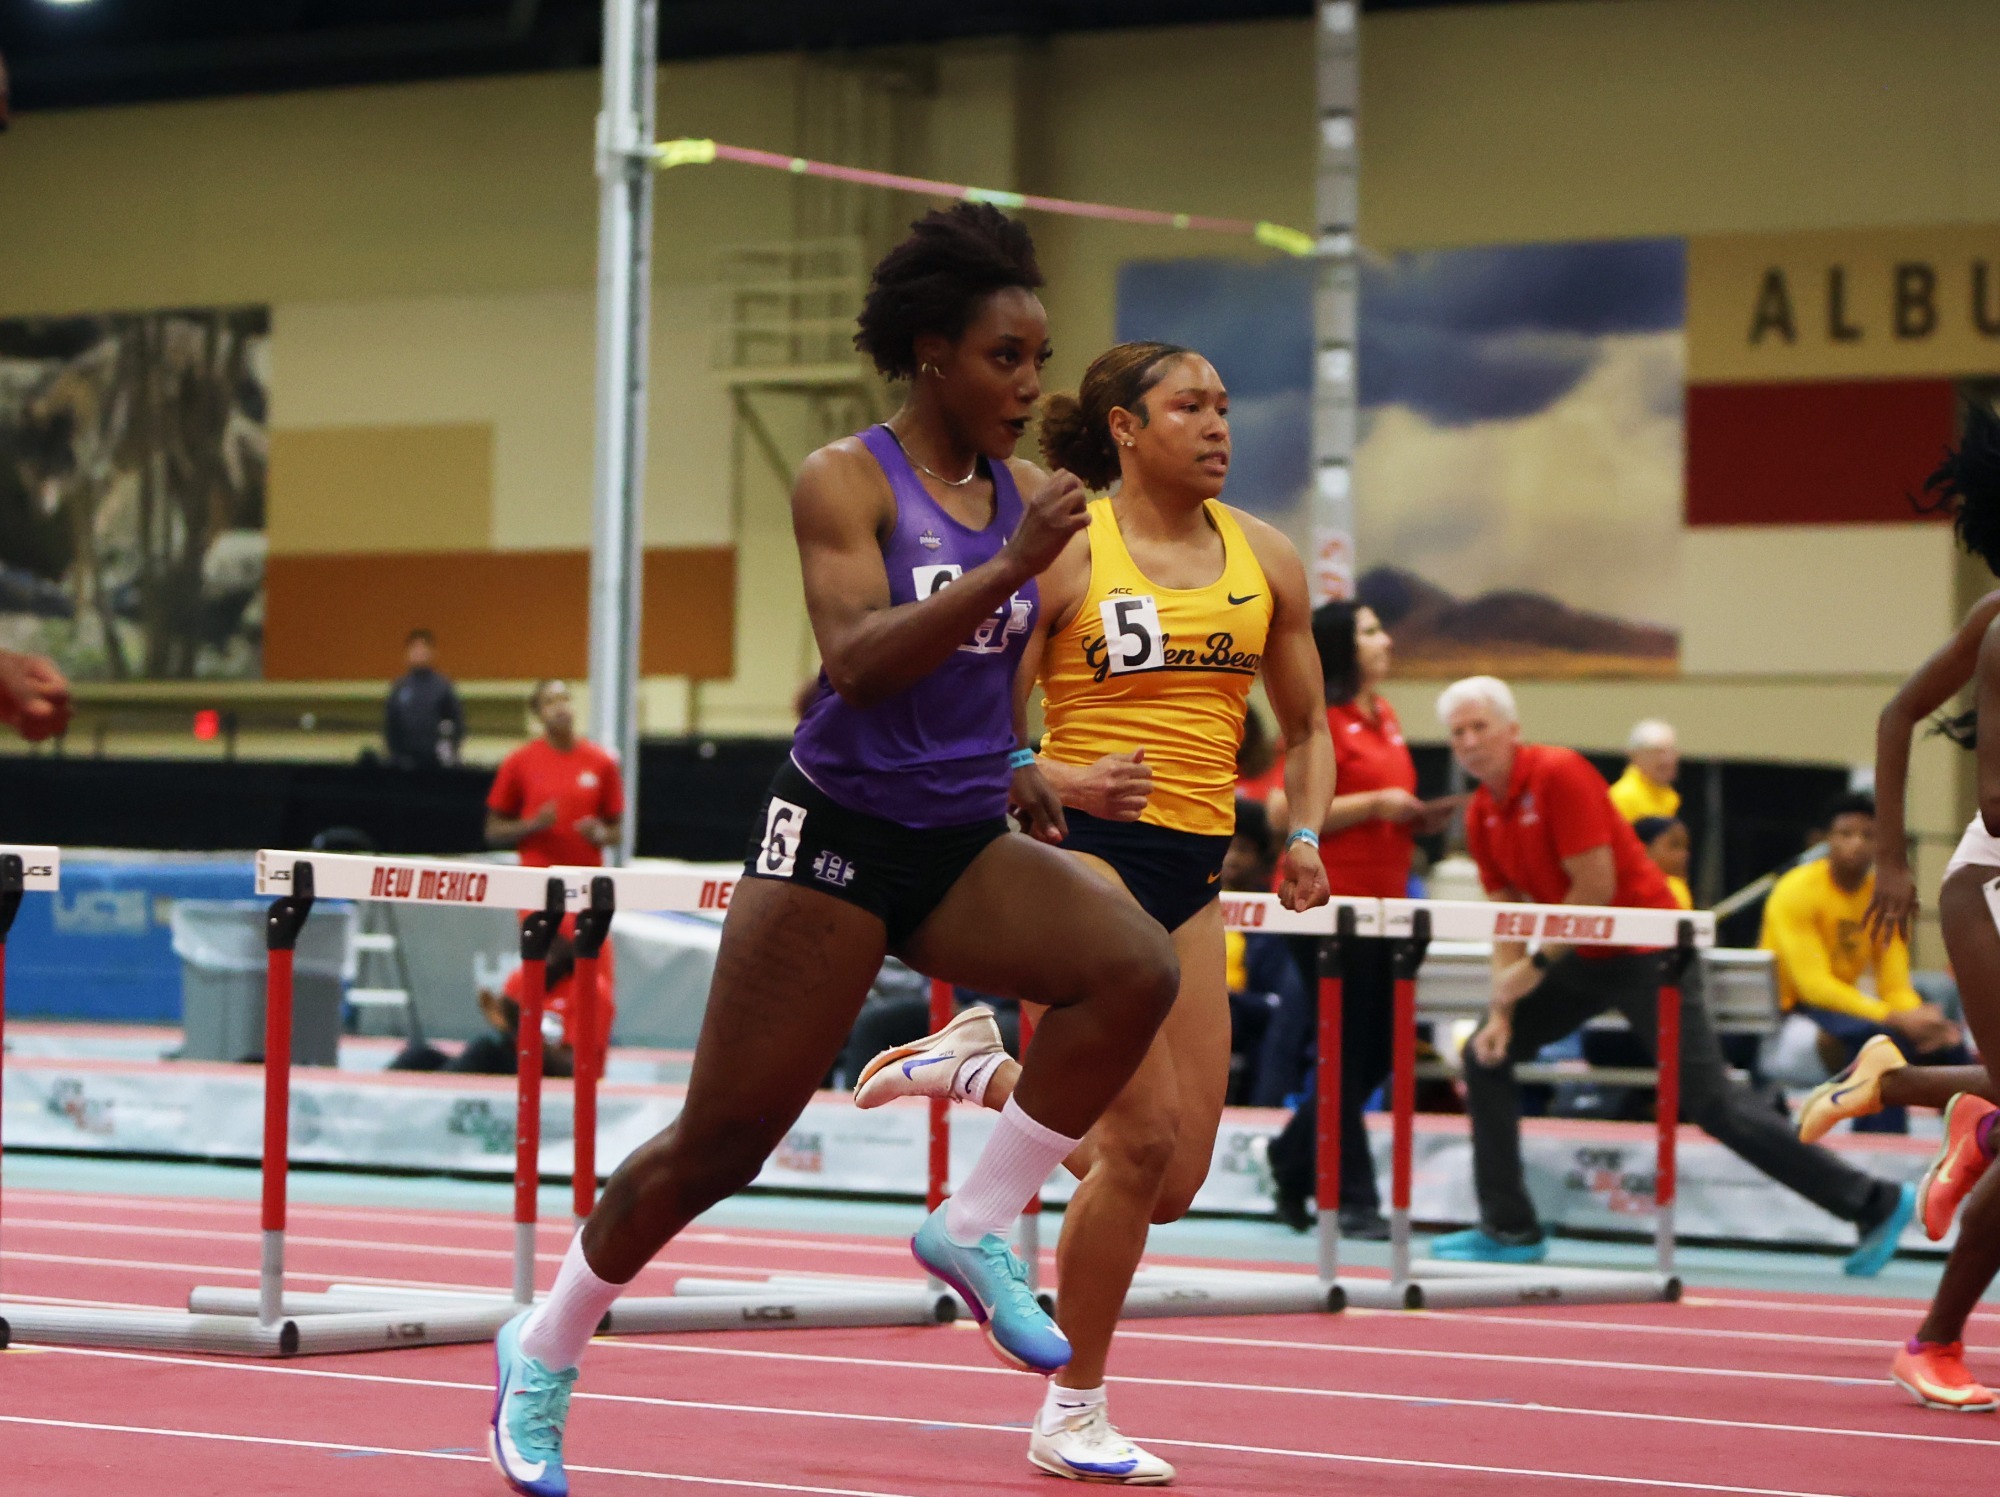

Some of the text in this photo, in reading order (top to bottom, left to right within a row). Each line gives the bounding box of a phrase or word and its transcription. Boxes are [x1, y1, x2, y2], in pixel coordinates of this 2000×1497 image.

[1108, 587, 1134, 595] ACC
[1114, 600, 1152, 667] 5
[766, 807, 793, 871] 6
[371, 866, 488, 902] NEW MEXICO
[699, 880, 733, 909] NE
[1543, 914, 1615, 940] MEXICO
